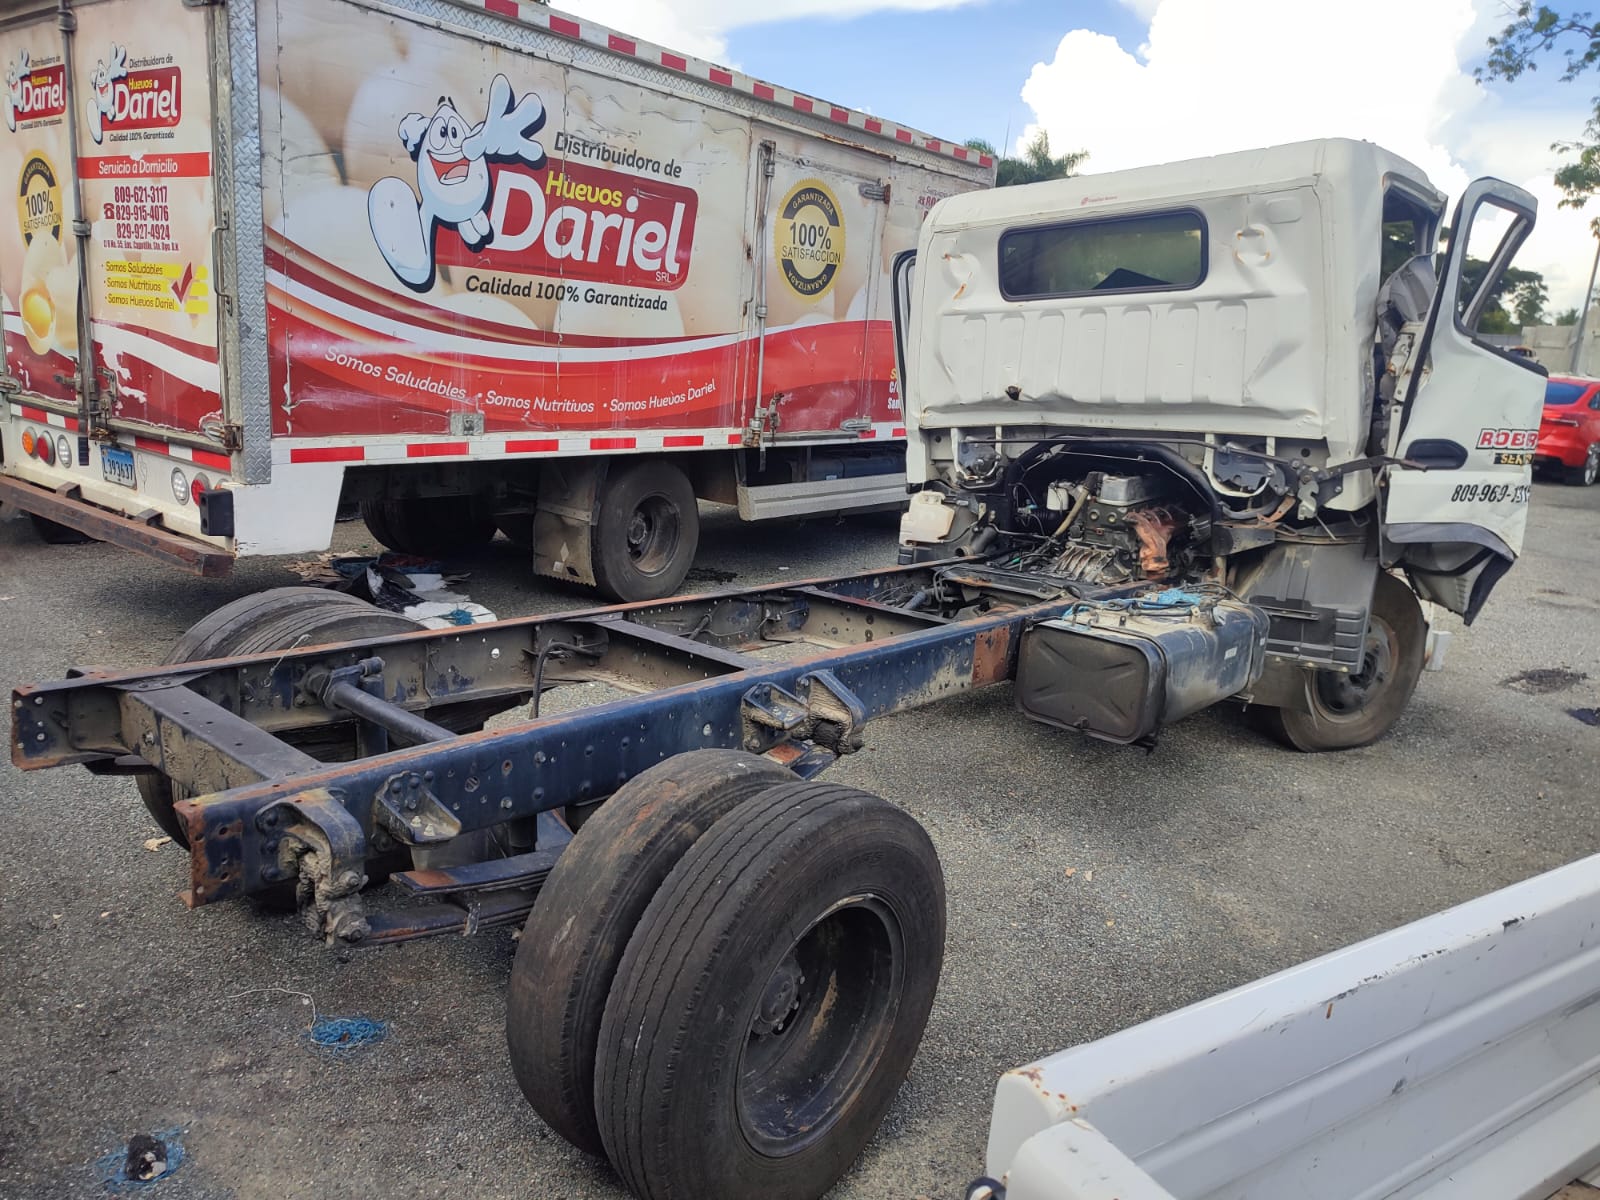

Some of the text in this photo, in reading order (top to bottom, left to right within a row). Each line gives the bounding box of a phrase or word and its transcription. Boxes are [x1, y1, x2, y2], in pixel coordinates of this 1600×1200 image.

[129, 53, 173, 68] Distribuidora de
[22, 72, 64, 112] Dariel
[128, 78, 152, 90] Huevos
[114, 76, 178, 121] Dariel
[554, 131, 682, 178] Distribuidora de
[140, 158, 178, 174] Domicilio
[114, 186, 168, 202] 809-621-3117
[545, 170, 623, 208] Huevos
[26, 190, 54, 218] 100%
[116, 205, 169, 221] 829-915-4076
[792, 192, 834, 215] GARANTIZADA
[24, 212, 62, 232] SATISFACCION
[116, 223, 170, 240] 829-927-4924
[485, 169, 686, 275] Dariel
[790, 222, 832, 250] 100%
[782, 245, 841, 264] SATISFACCION
[106, 261, 163, 275] Somos Saludables
[655, 271, 672, 283] SRL
[107, 278, 128, 289] Somos
[466, 274, 668, 311] Calidad 100% Garantizada
[108, 294, 128, 305] Somos
[155, 298, 174, 310] Dariel
[324, 345, 467, 400] Somos Saludables
[486, 390, 594, 412] Somos Nutritivos
[610, 379, 716, 412] Somos Huevos Dariel
